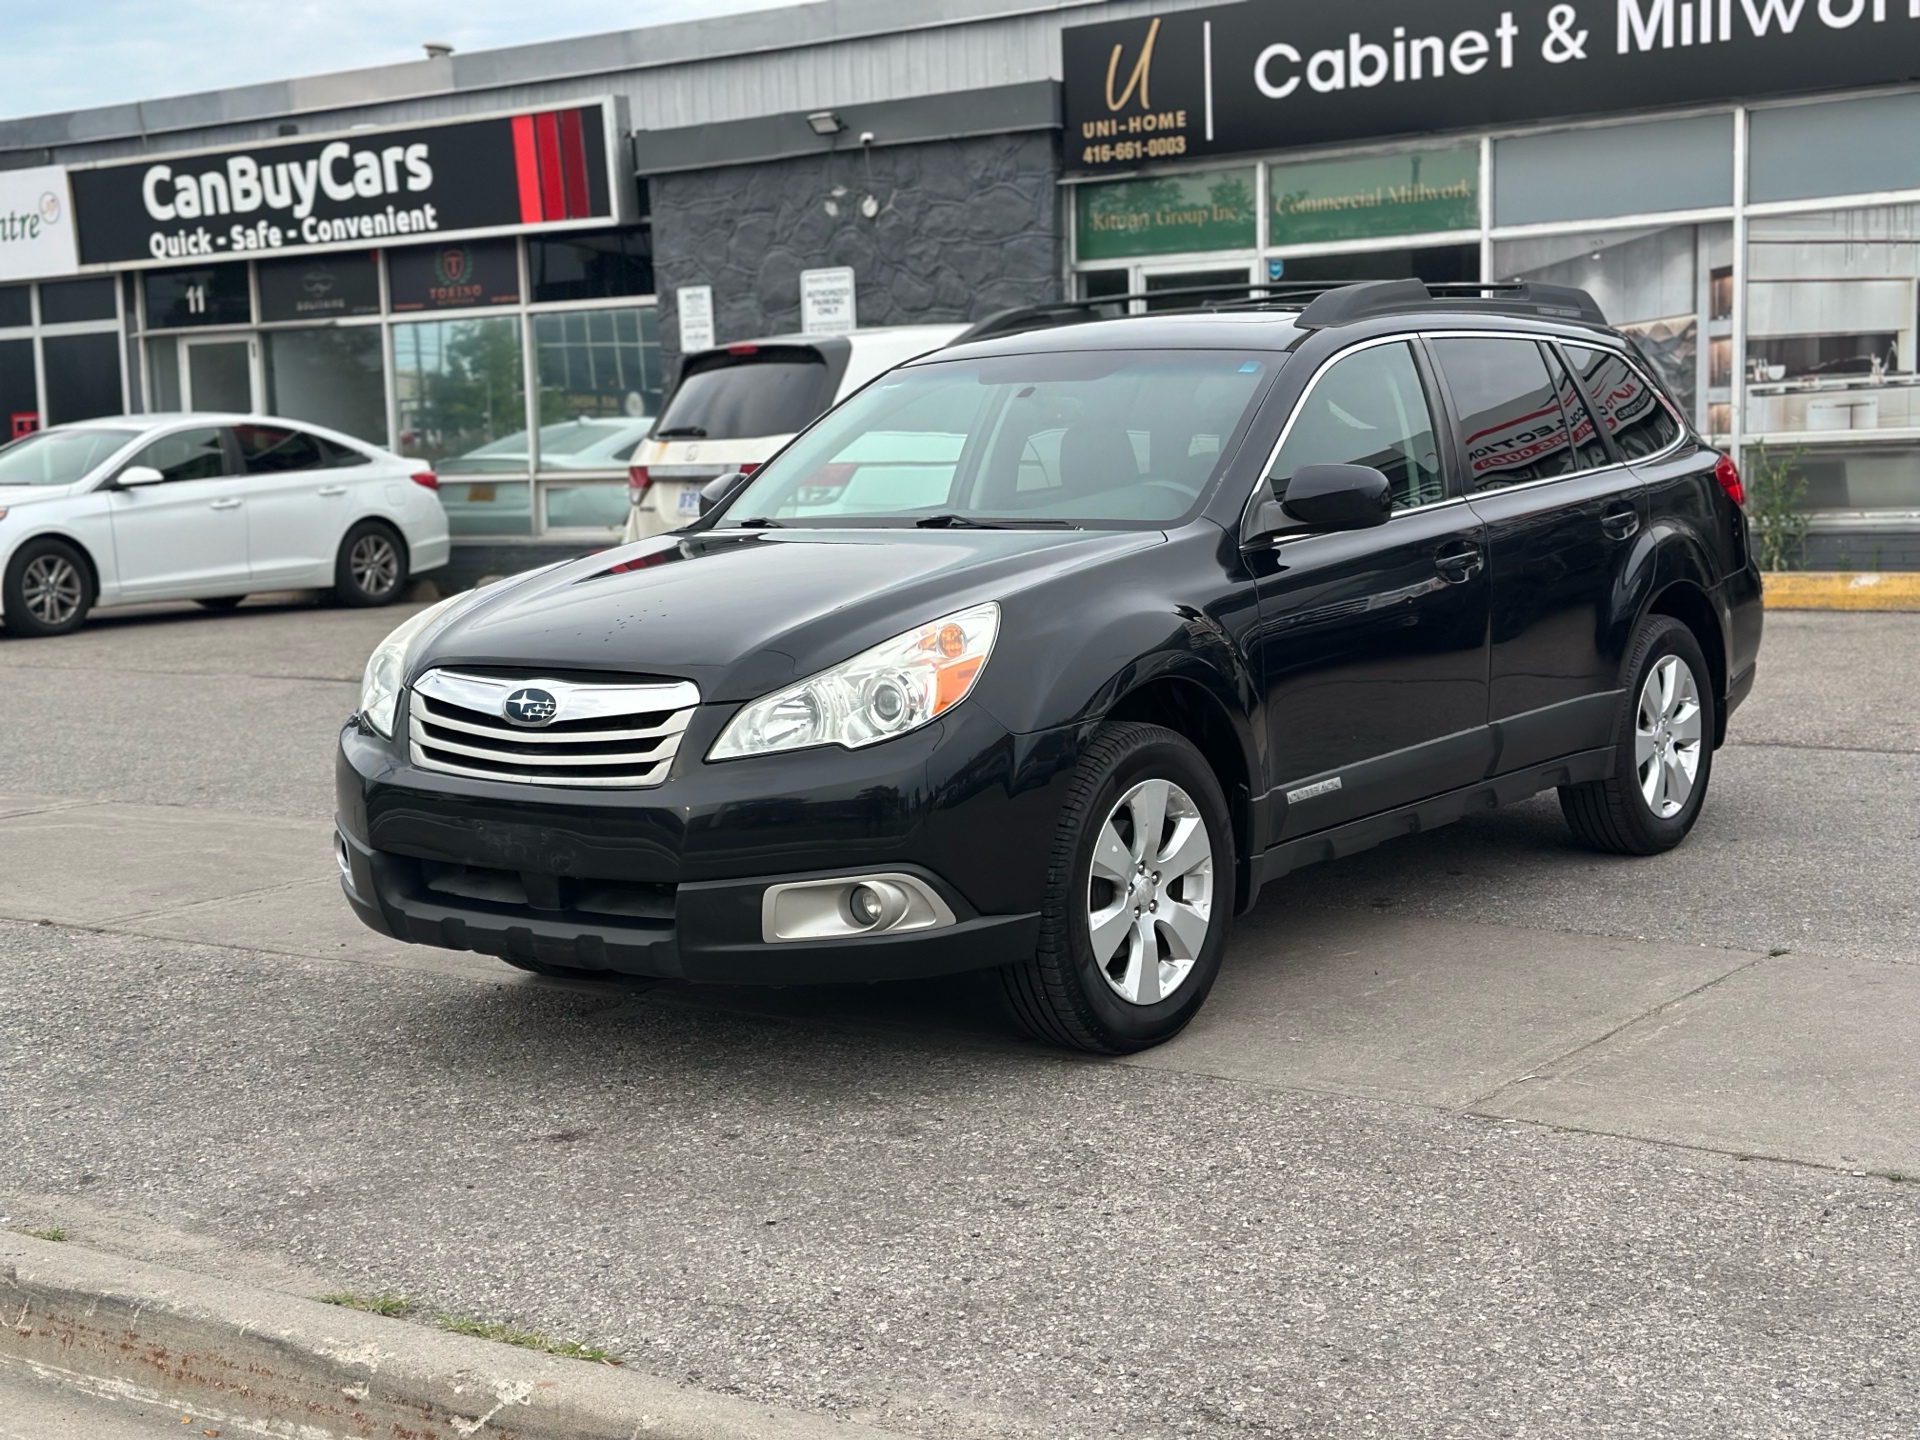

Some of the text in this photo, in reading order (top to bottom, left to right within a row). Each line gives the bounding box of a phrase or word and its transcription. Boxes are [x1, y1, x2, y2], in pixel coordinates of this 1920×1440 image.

[1254, 0, 1920, 99] Cabinet & Millwo
[1082, 110, 1187, 139] UNI-HOME
[1082, 136, 1187, 164] 416-661-0003
[142, 141, 433, 221] CanBuyCars
[1274, 178, 1472, 216] Commercial Millwork
[149, 226, 213, 259] Quick
[230, 220, 282, 251] Safe
[301, 203, 438, 243] Convenient
[1155, 206, 1208, 228] Group
[185, 285, 205, 314] 11
